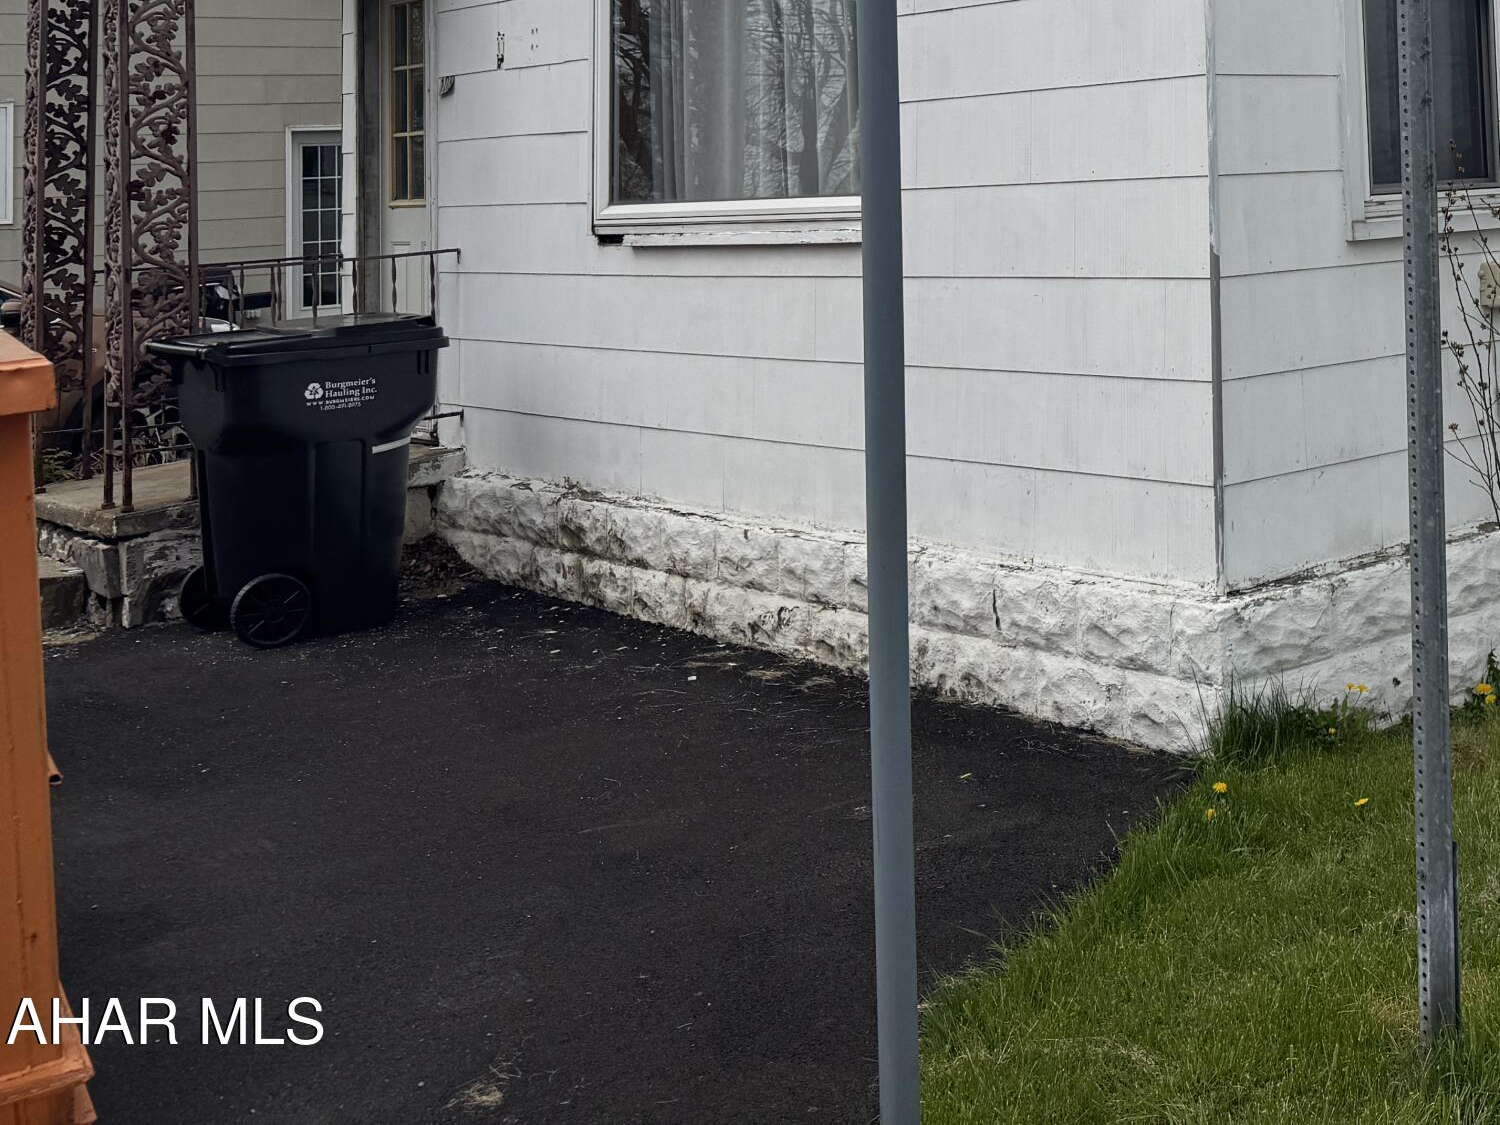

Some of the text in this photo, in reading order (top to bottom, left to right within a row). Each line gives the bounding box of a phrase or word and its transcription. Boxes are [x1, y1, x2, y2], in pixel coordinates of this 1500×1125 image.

[325, 377, 376, 390] Burgmeier's
[325, 386, 378, 398] Hauling Inc.
